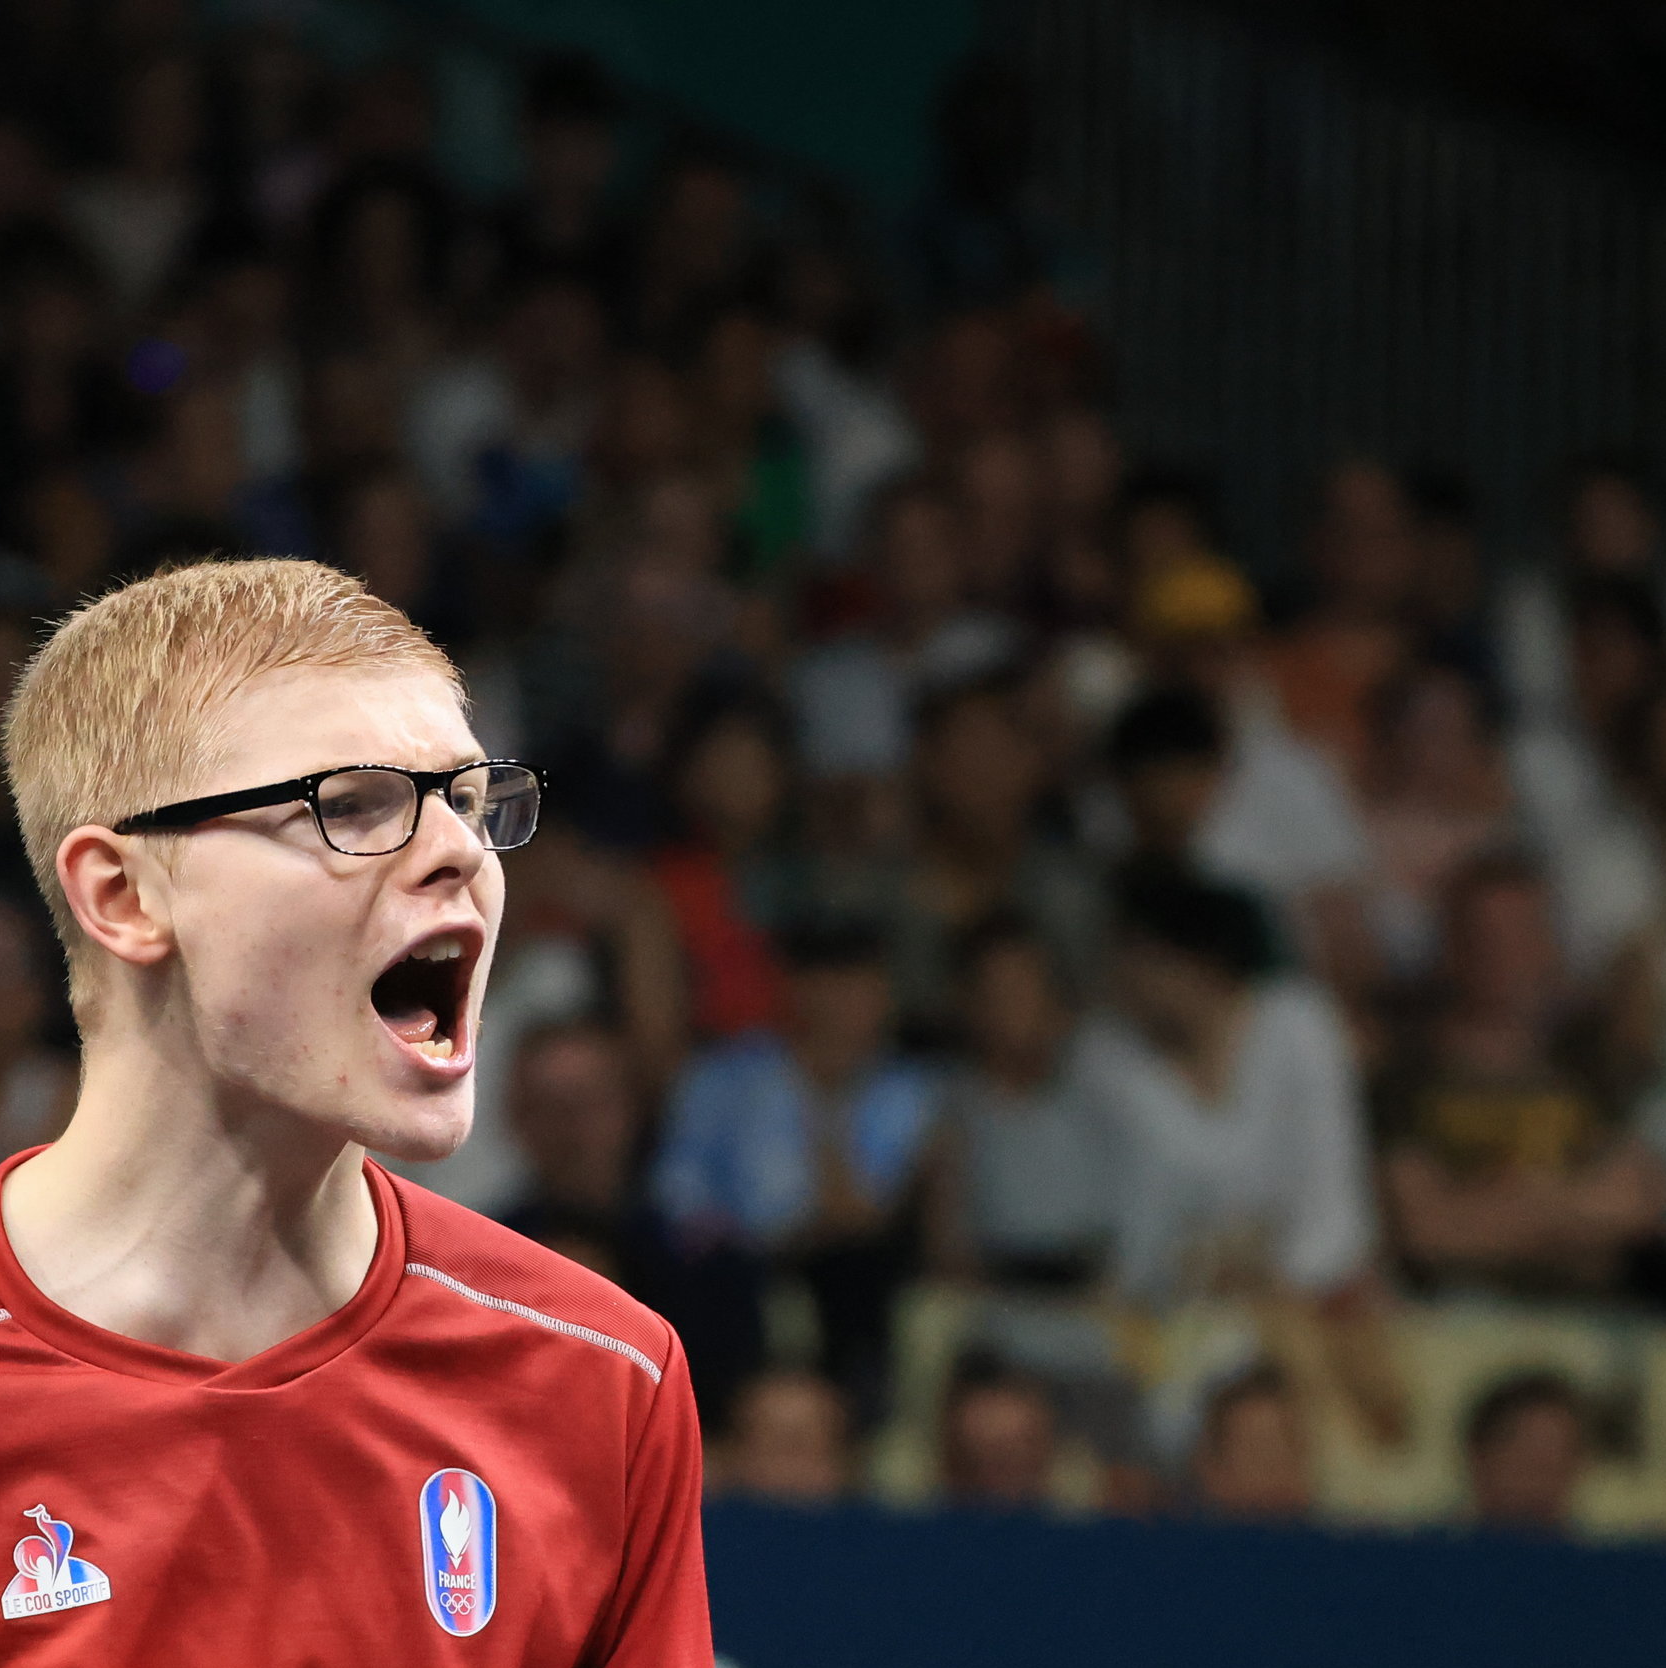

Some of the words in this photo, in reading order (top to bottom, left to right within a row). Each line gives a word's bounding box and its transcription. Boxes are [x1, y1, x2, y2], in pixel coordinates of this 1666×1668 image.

[438, 1569, 477, 1590] FRANCE
[4, 1597, 22, 1615] LE
[24, 1592, 53, 1612] COQ
[54, 1580, 107, 1607] SPORTIF
